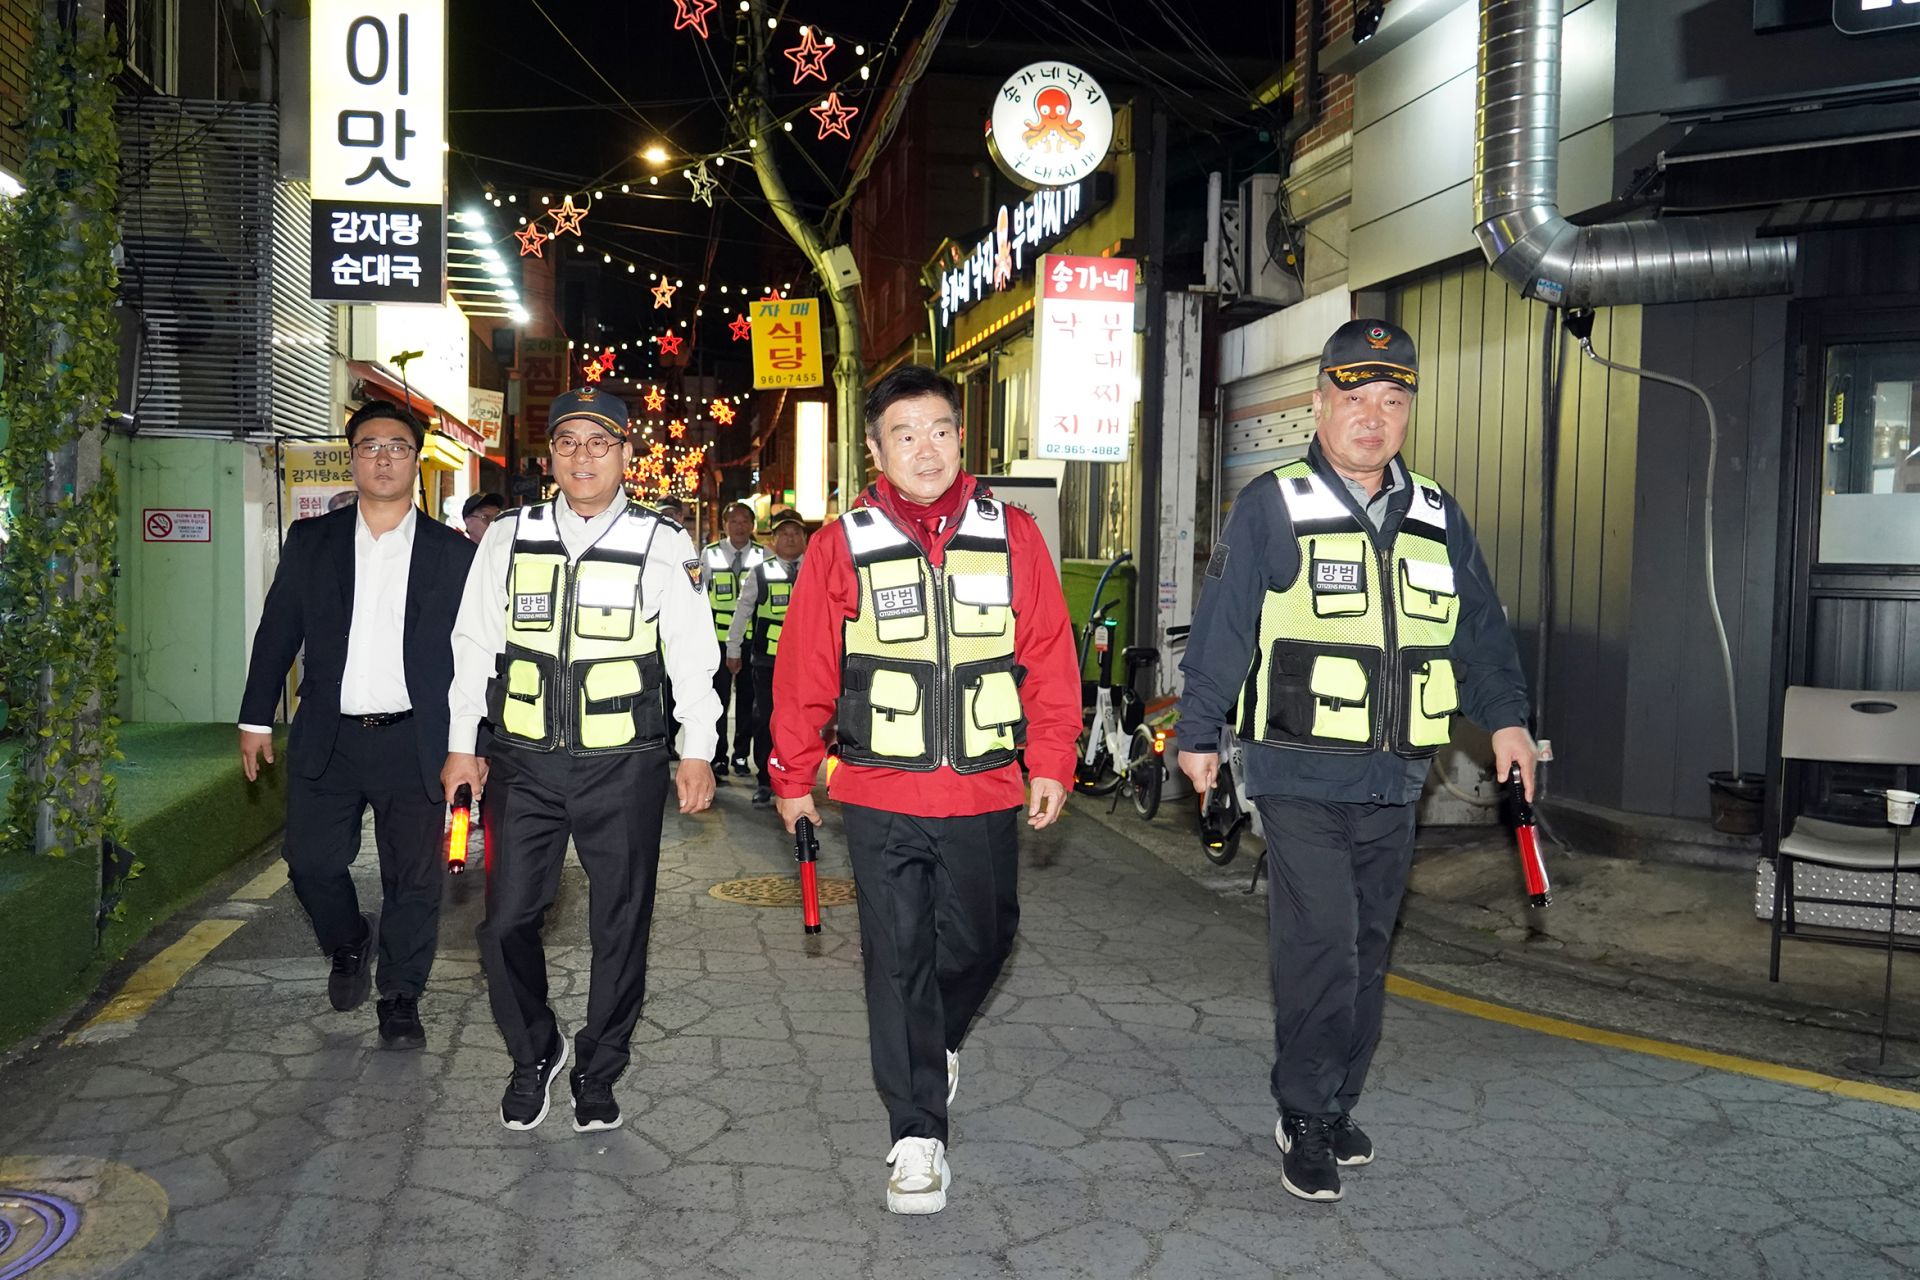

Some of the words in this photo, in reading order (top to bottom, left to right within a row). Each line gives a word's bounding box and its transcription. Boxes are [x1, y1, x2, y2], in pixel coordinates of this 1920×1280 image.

[331, 211, 422, 246] 감자탕
[331, 253, 422, 288] 순대국
[1051, 260, 1129, 293] 송가네
[768, 321, 807, 370] 식당
[760, 373, 817, 384] 960-7455
[1093, 313, 1122, 434] 부대찌개
[299, 497, 321, 509] 점심
[1322, 565, 1354, 582] 방범
[521, 596, 546, 612] 방범
[881, 588, 913, 608] 방범
